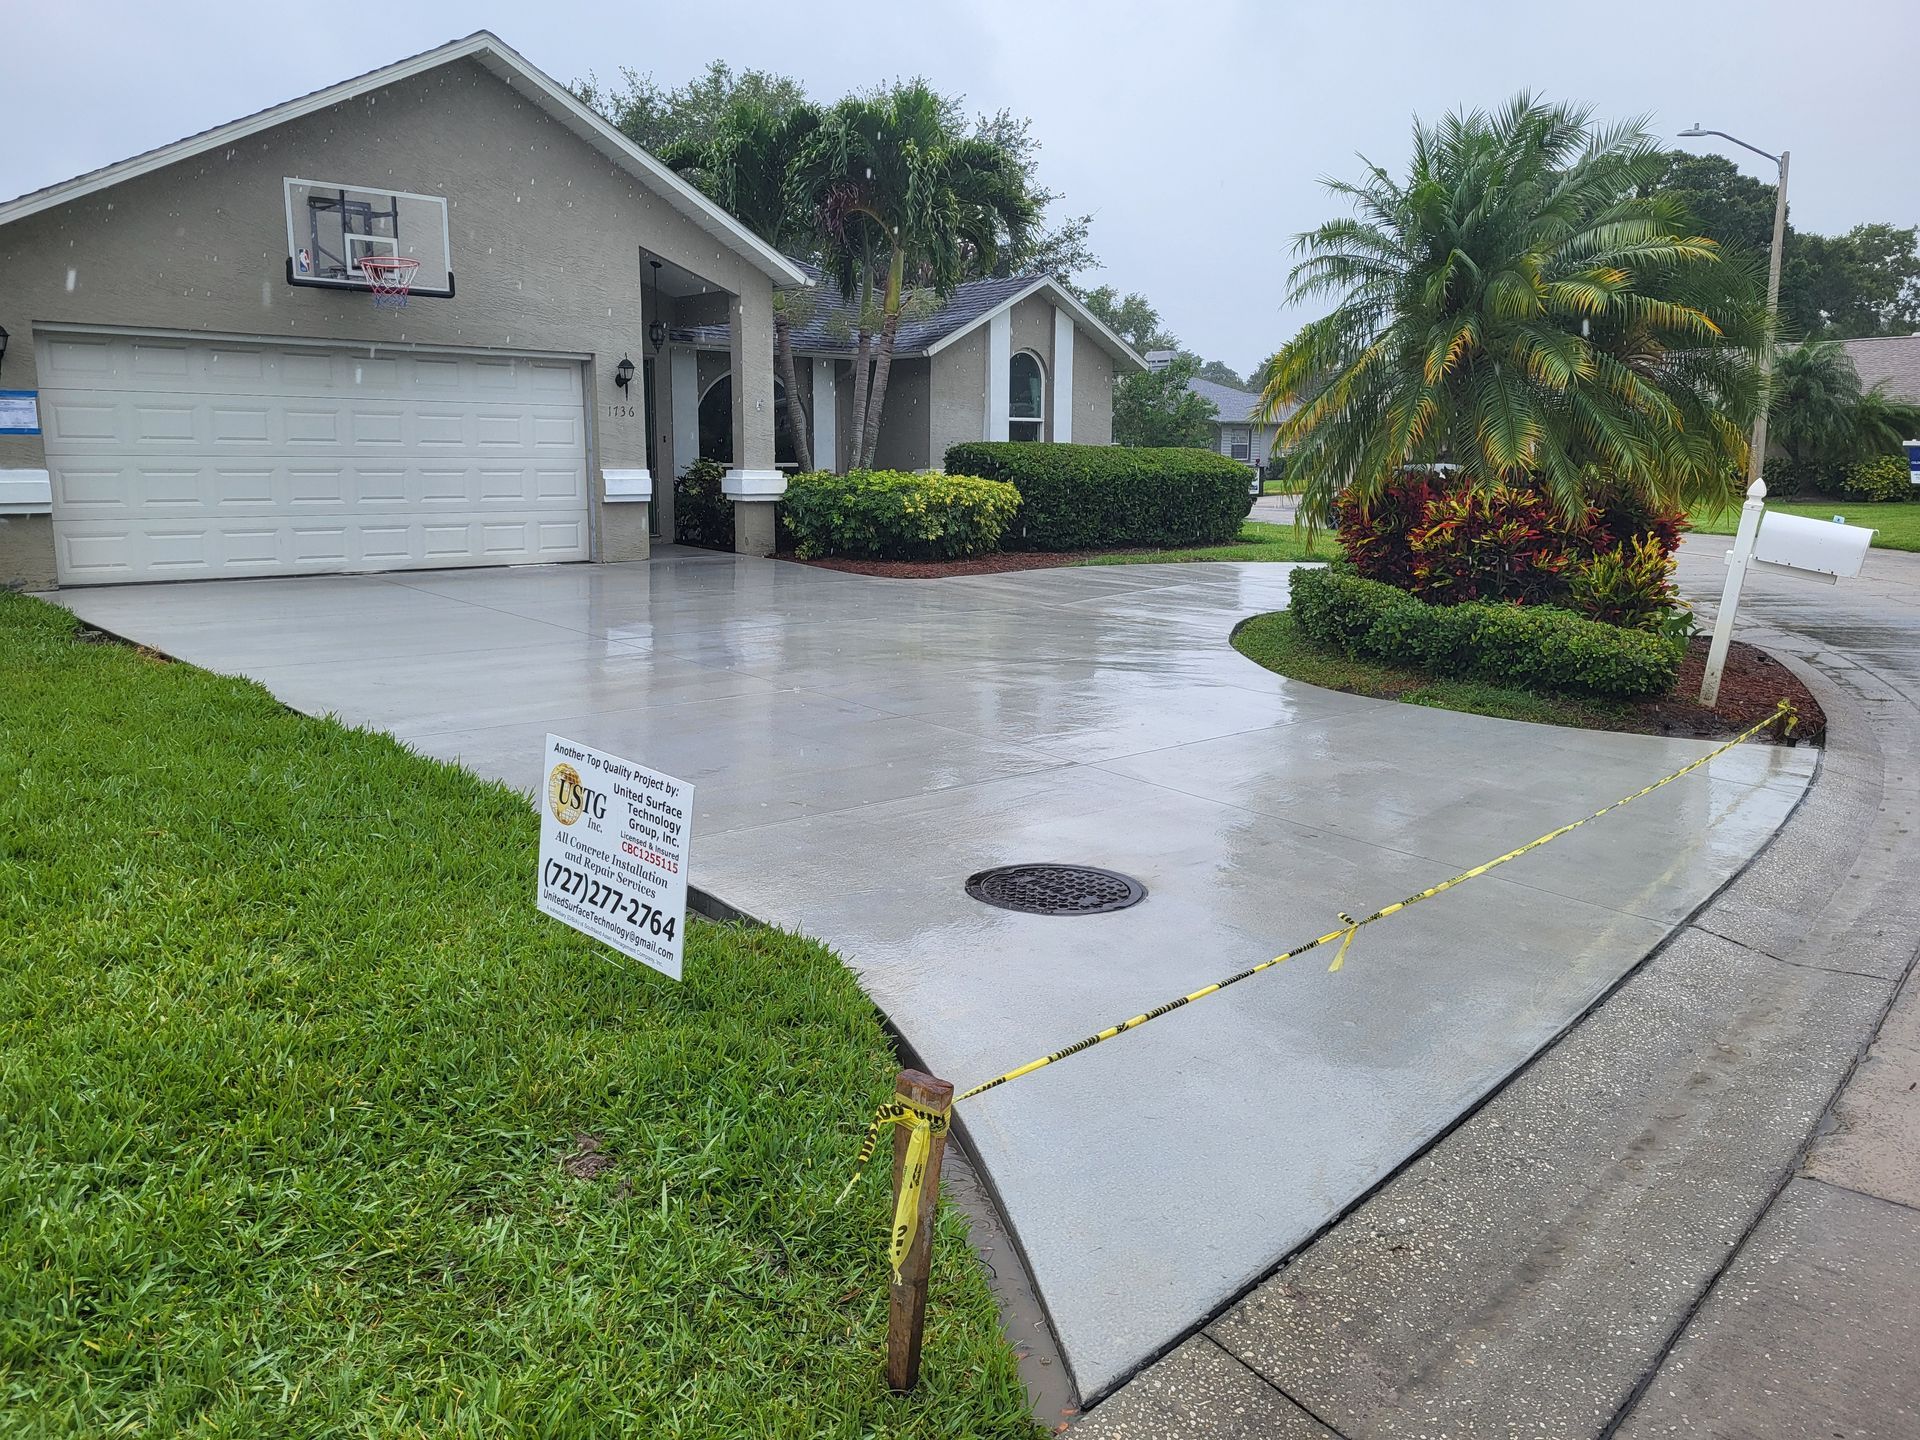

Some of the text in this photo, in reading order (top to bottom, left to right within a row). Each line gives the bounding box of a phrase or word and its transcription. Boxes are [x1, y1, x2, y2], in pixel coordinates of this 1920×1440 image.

[608, 405, 635, 418] 1736
[553, 742, 680, 798] Another Top Quality Project by:
[558, 778, 608, 820] USTG
[613, 782, 683, 819] United Surface
[587, 817, 603, 834] Inc.
[627, 802, 682, 836] Technology
[628, 818, 680, 849] Group, Inc.
[555, 830, 668, 889] All Concrete Installation
[620, 830, 680, 862] Licensed & Insured
[621, 841, 679, 875] CBC1255115
[564, 851, 657, 900] and Repair Services
[544, 857, 676, 943] (727)277-2764
[543, 888, 674, 962] UnitedSurfaceTechnology@gmail.com
